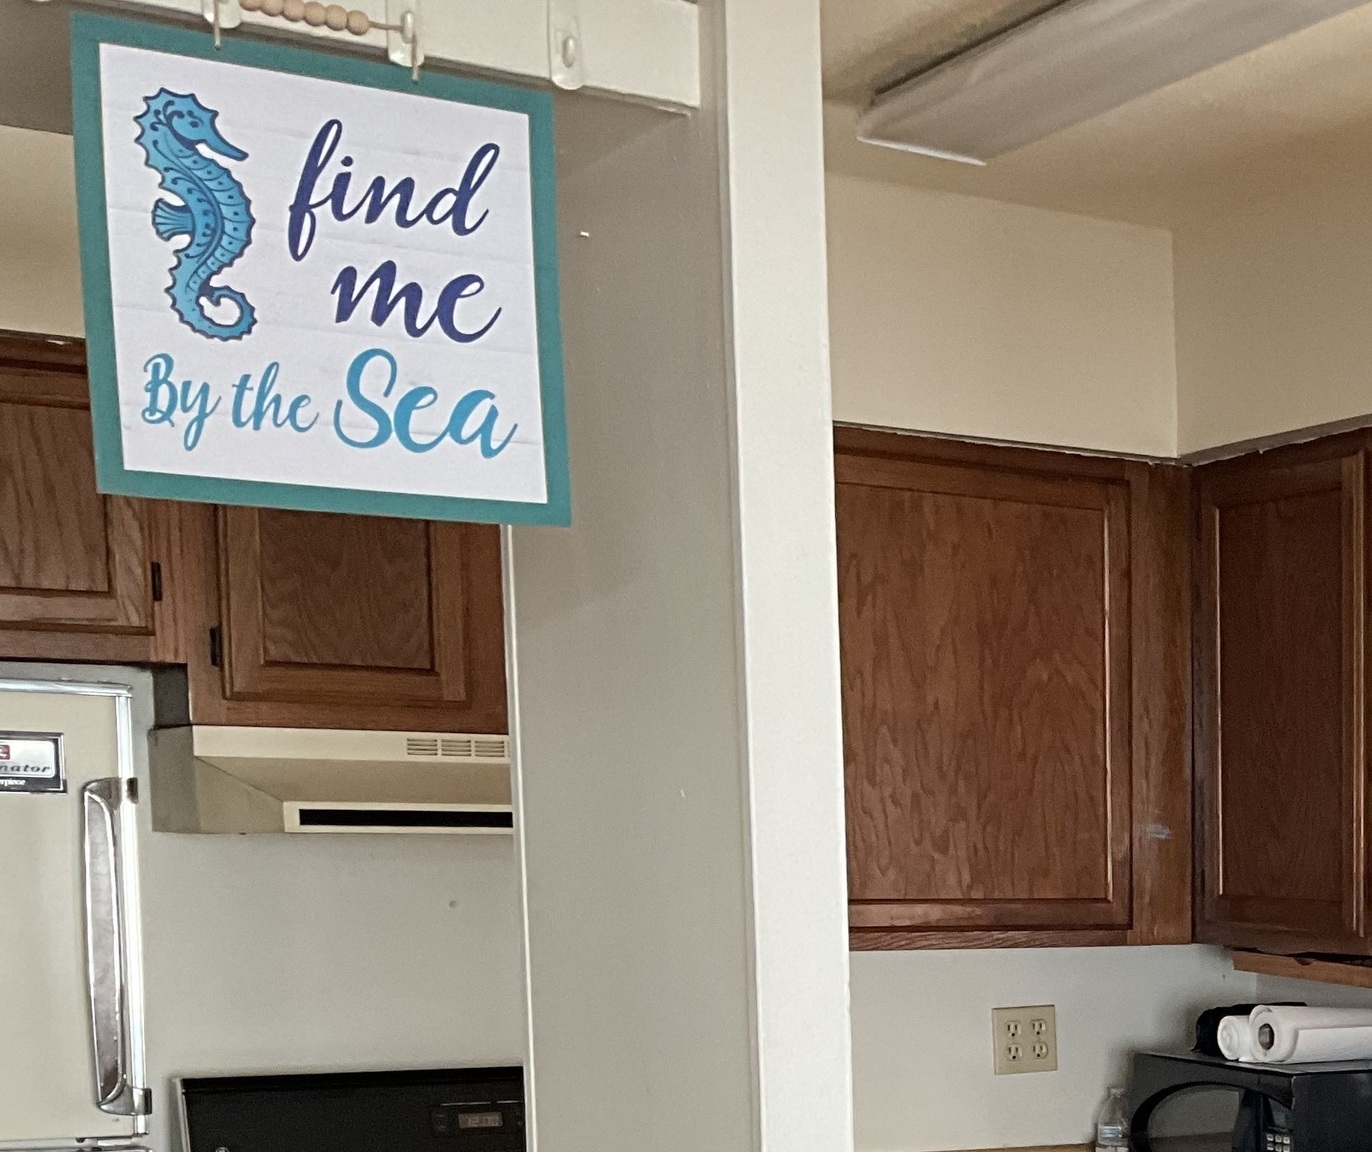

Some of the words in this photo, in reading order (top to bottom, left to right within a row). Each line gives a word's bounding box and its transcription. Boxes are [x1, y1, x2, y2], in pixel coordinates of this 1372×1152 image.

[288, 118, 501, 261] find
[330, 258, 503, 345] me
[140, 352, 222, 452] By
[231, 361, 319, 433] the
[333, 347, 518, 460] Sea
